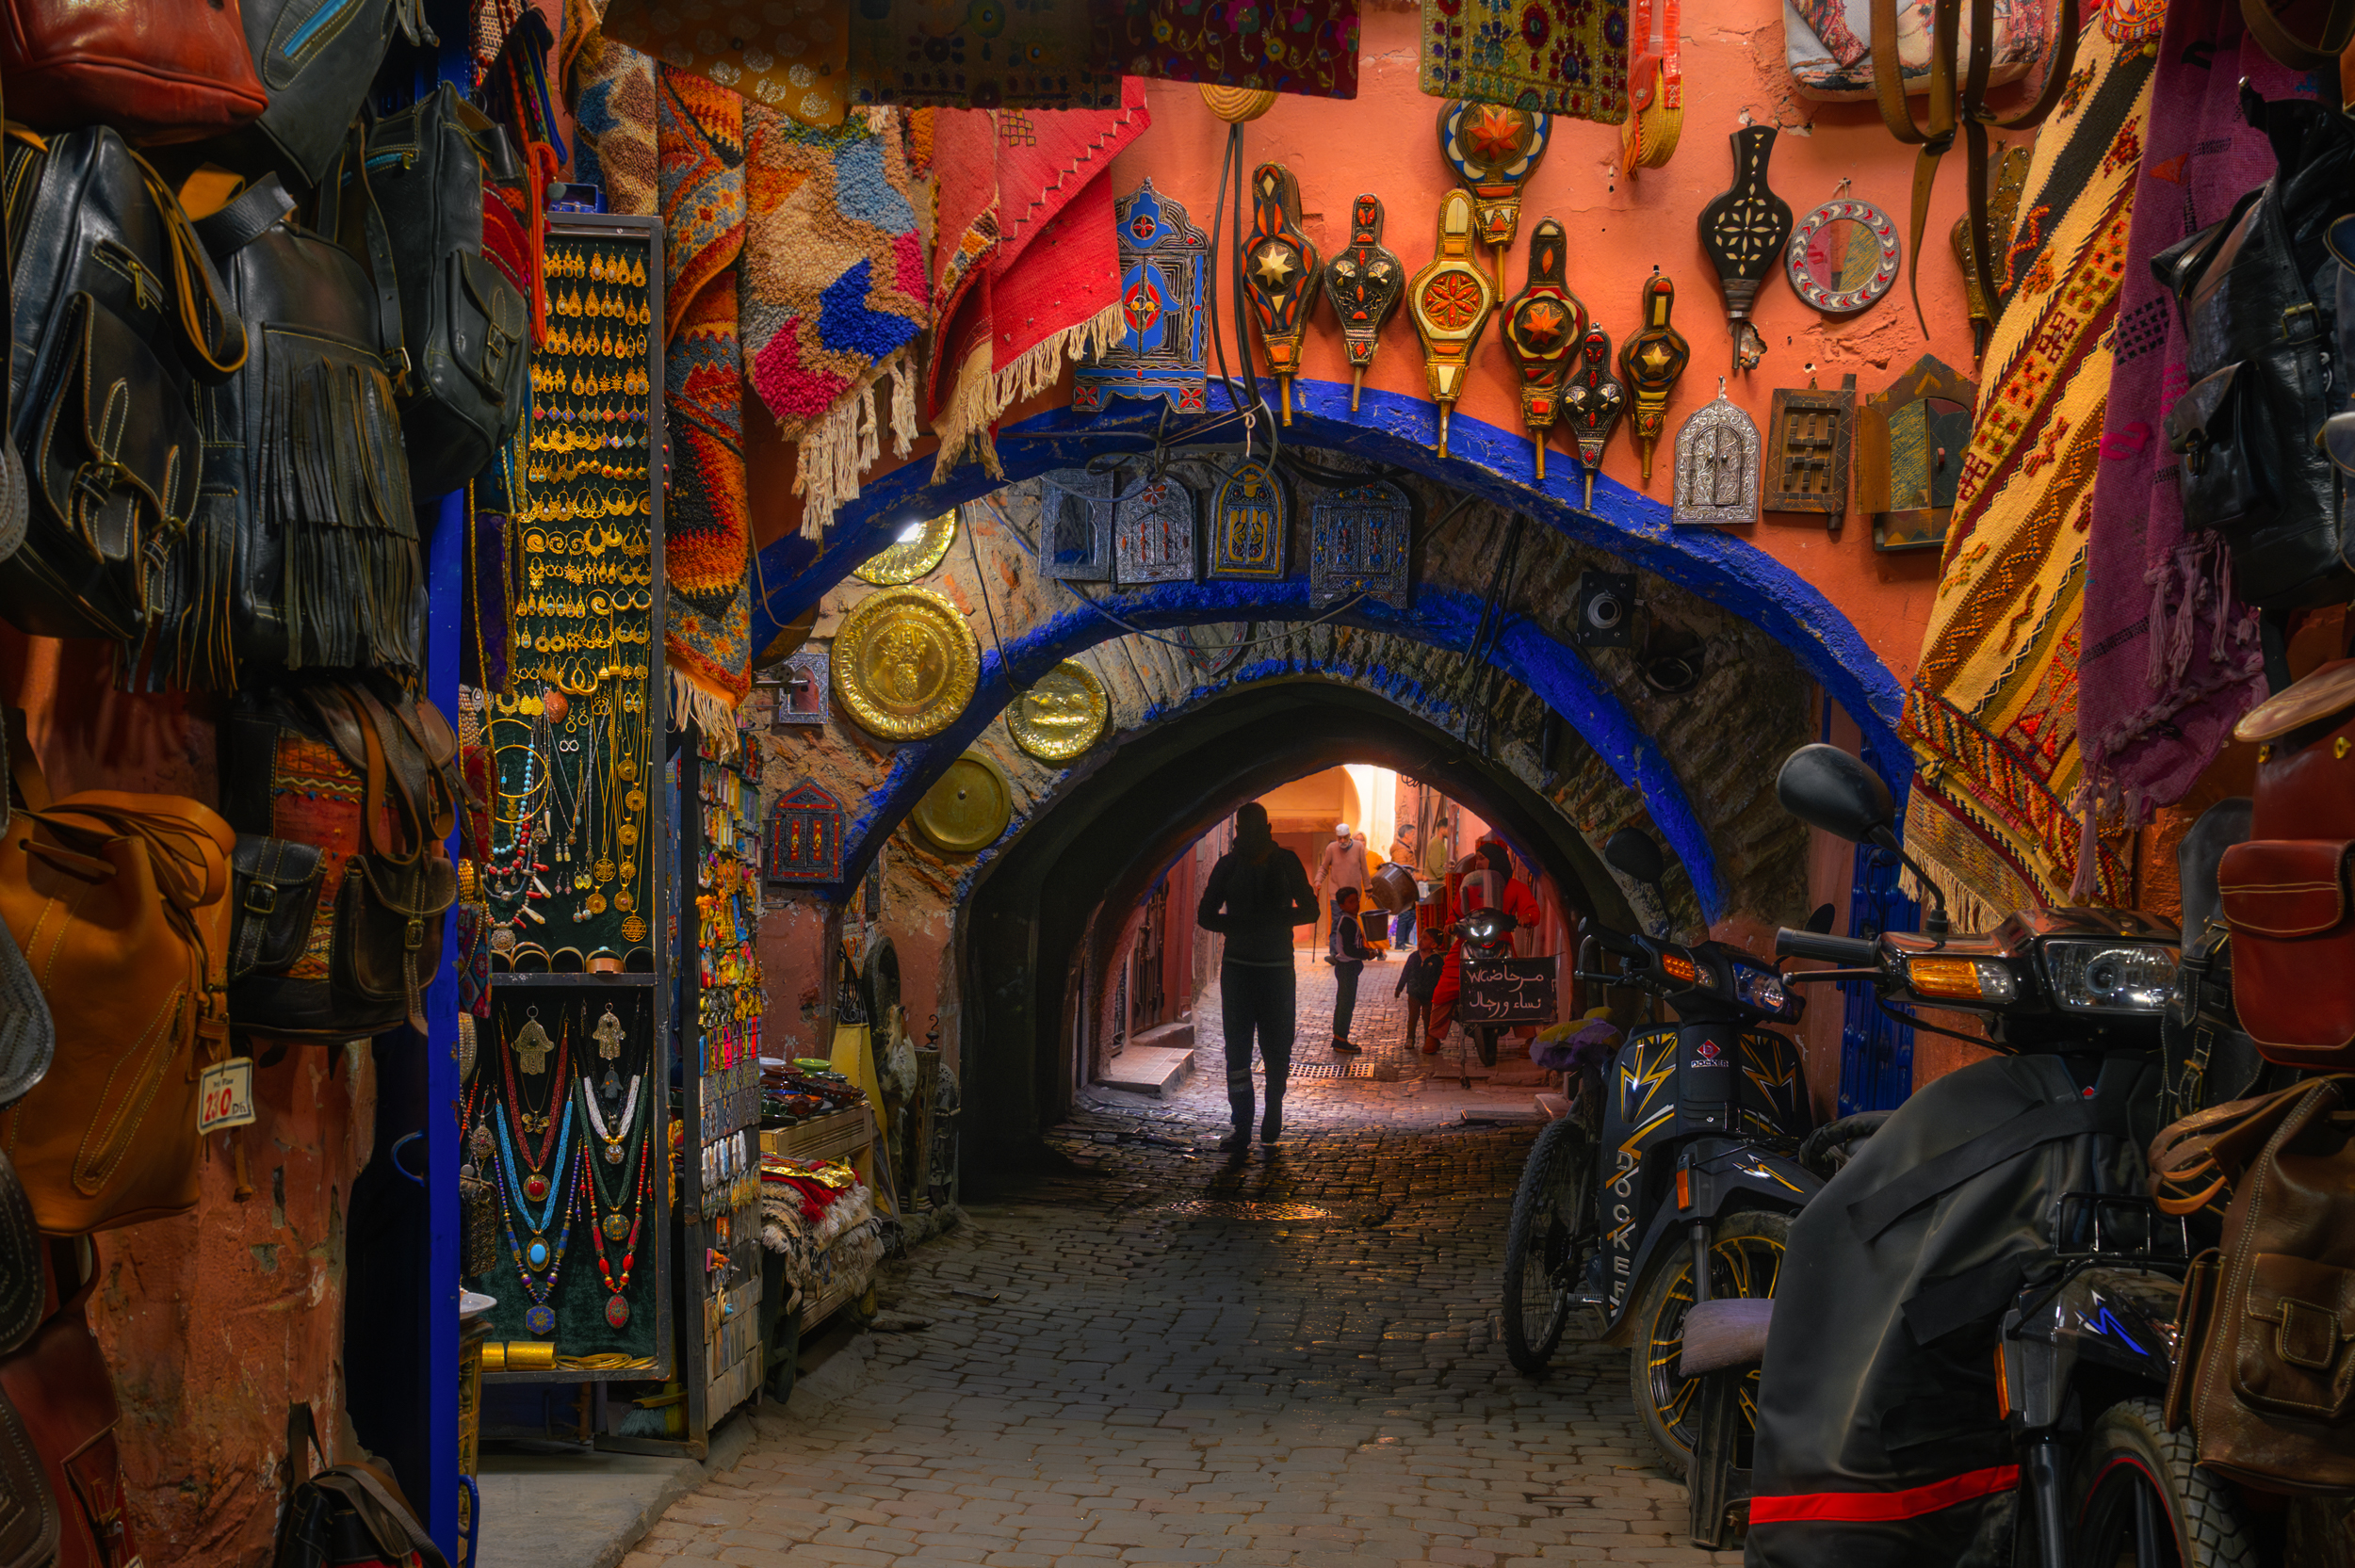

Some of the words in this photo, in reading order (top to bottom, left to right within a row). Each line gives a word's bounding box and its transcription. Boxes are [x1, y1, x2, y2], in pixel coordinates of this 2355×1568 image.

[1466, 968, 1488, 983] WC
[1691, 1059, 1730, 1068] DOCKER
[204, 1088, 232, 1123] 230
[232, 1101, 247, 1114] Dh
